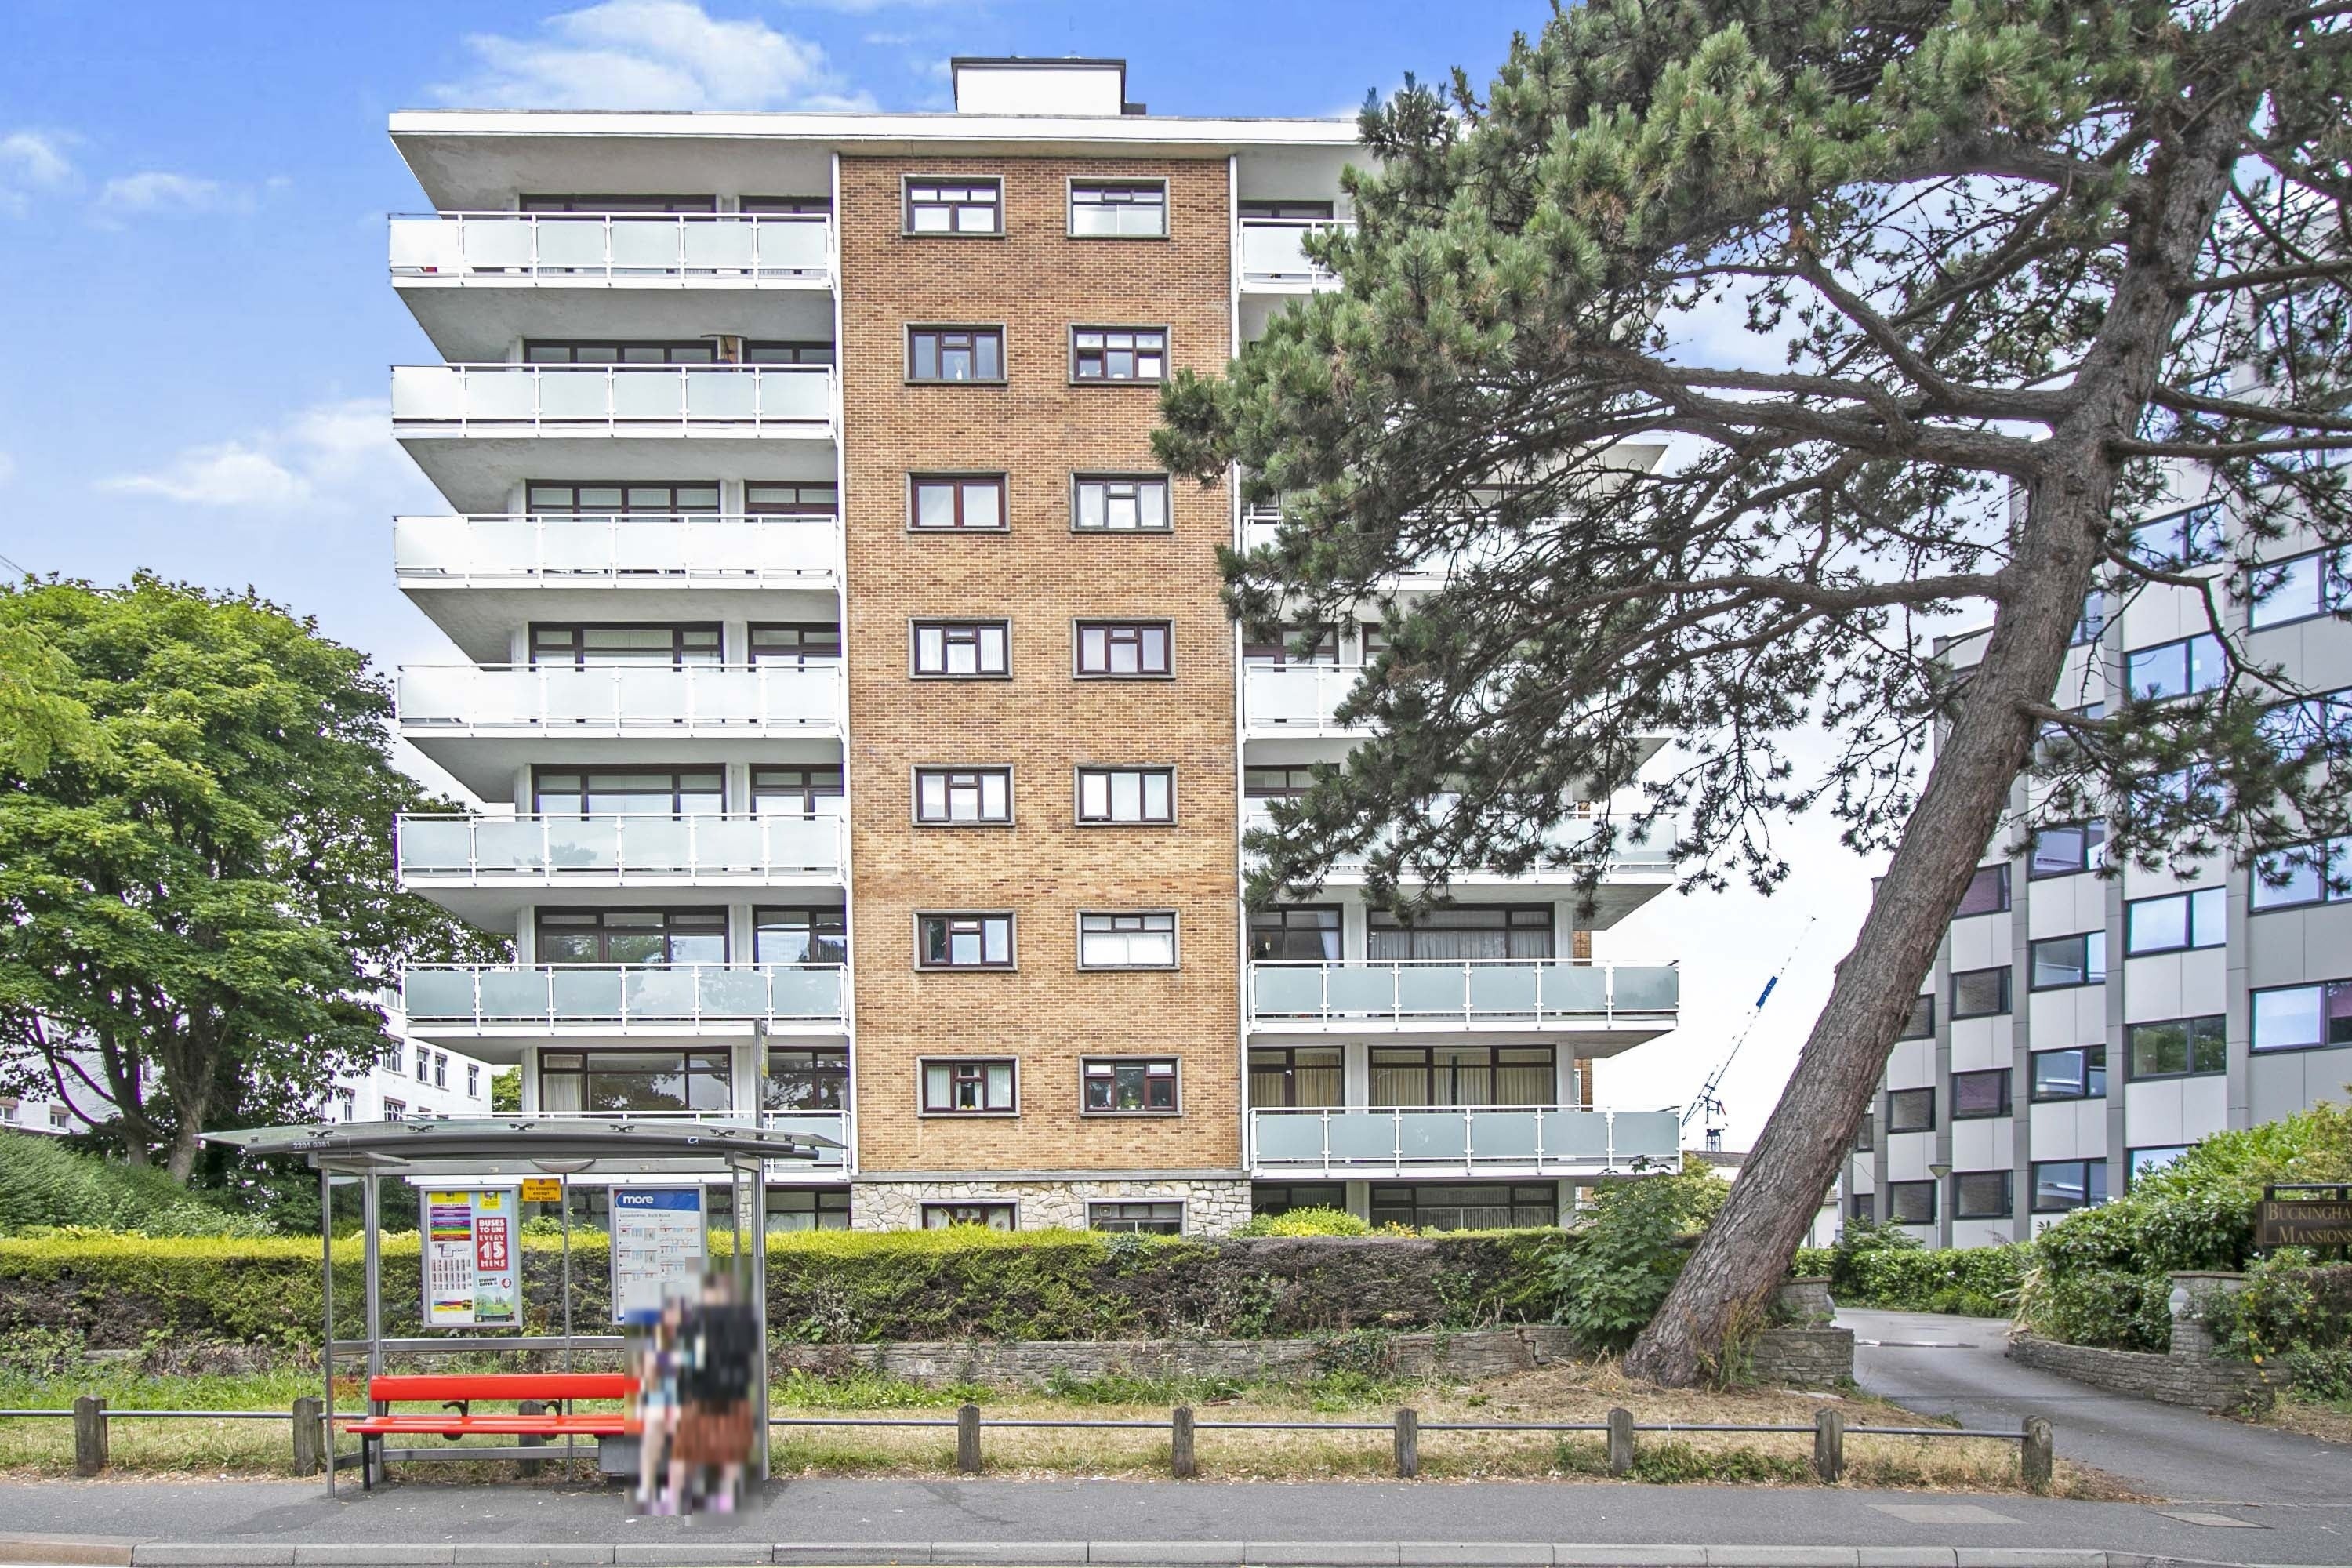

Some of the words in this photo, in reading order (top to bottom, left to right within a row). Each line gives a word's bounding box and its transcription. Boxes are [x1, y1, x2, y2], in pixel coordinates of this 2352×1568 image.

[623, 1195, 654, 1204] more
[2269, 1203, 2352, 1221] BUCKINGHA
[2278, 1225, 2352, 1243] MANSIONS
[481, 1241, 505, 1260] 15
[481, 1259, 506, 1268] MINS
